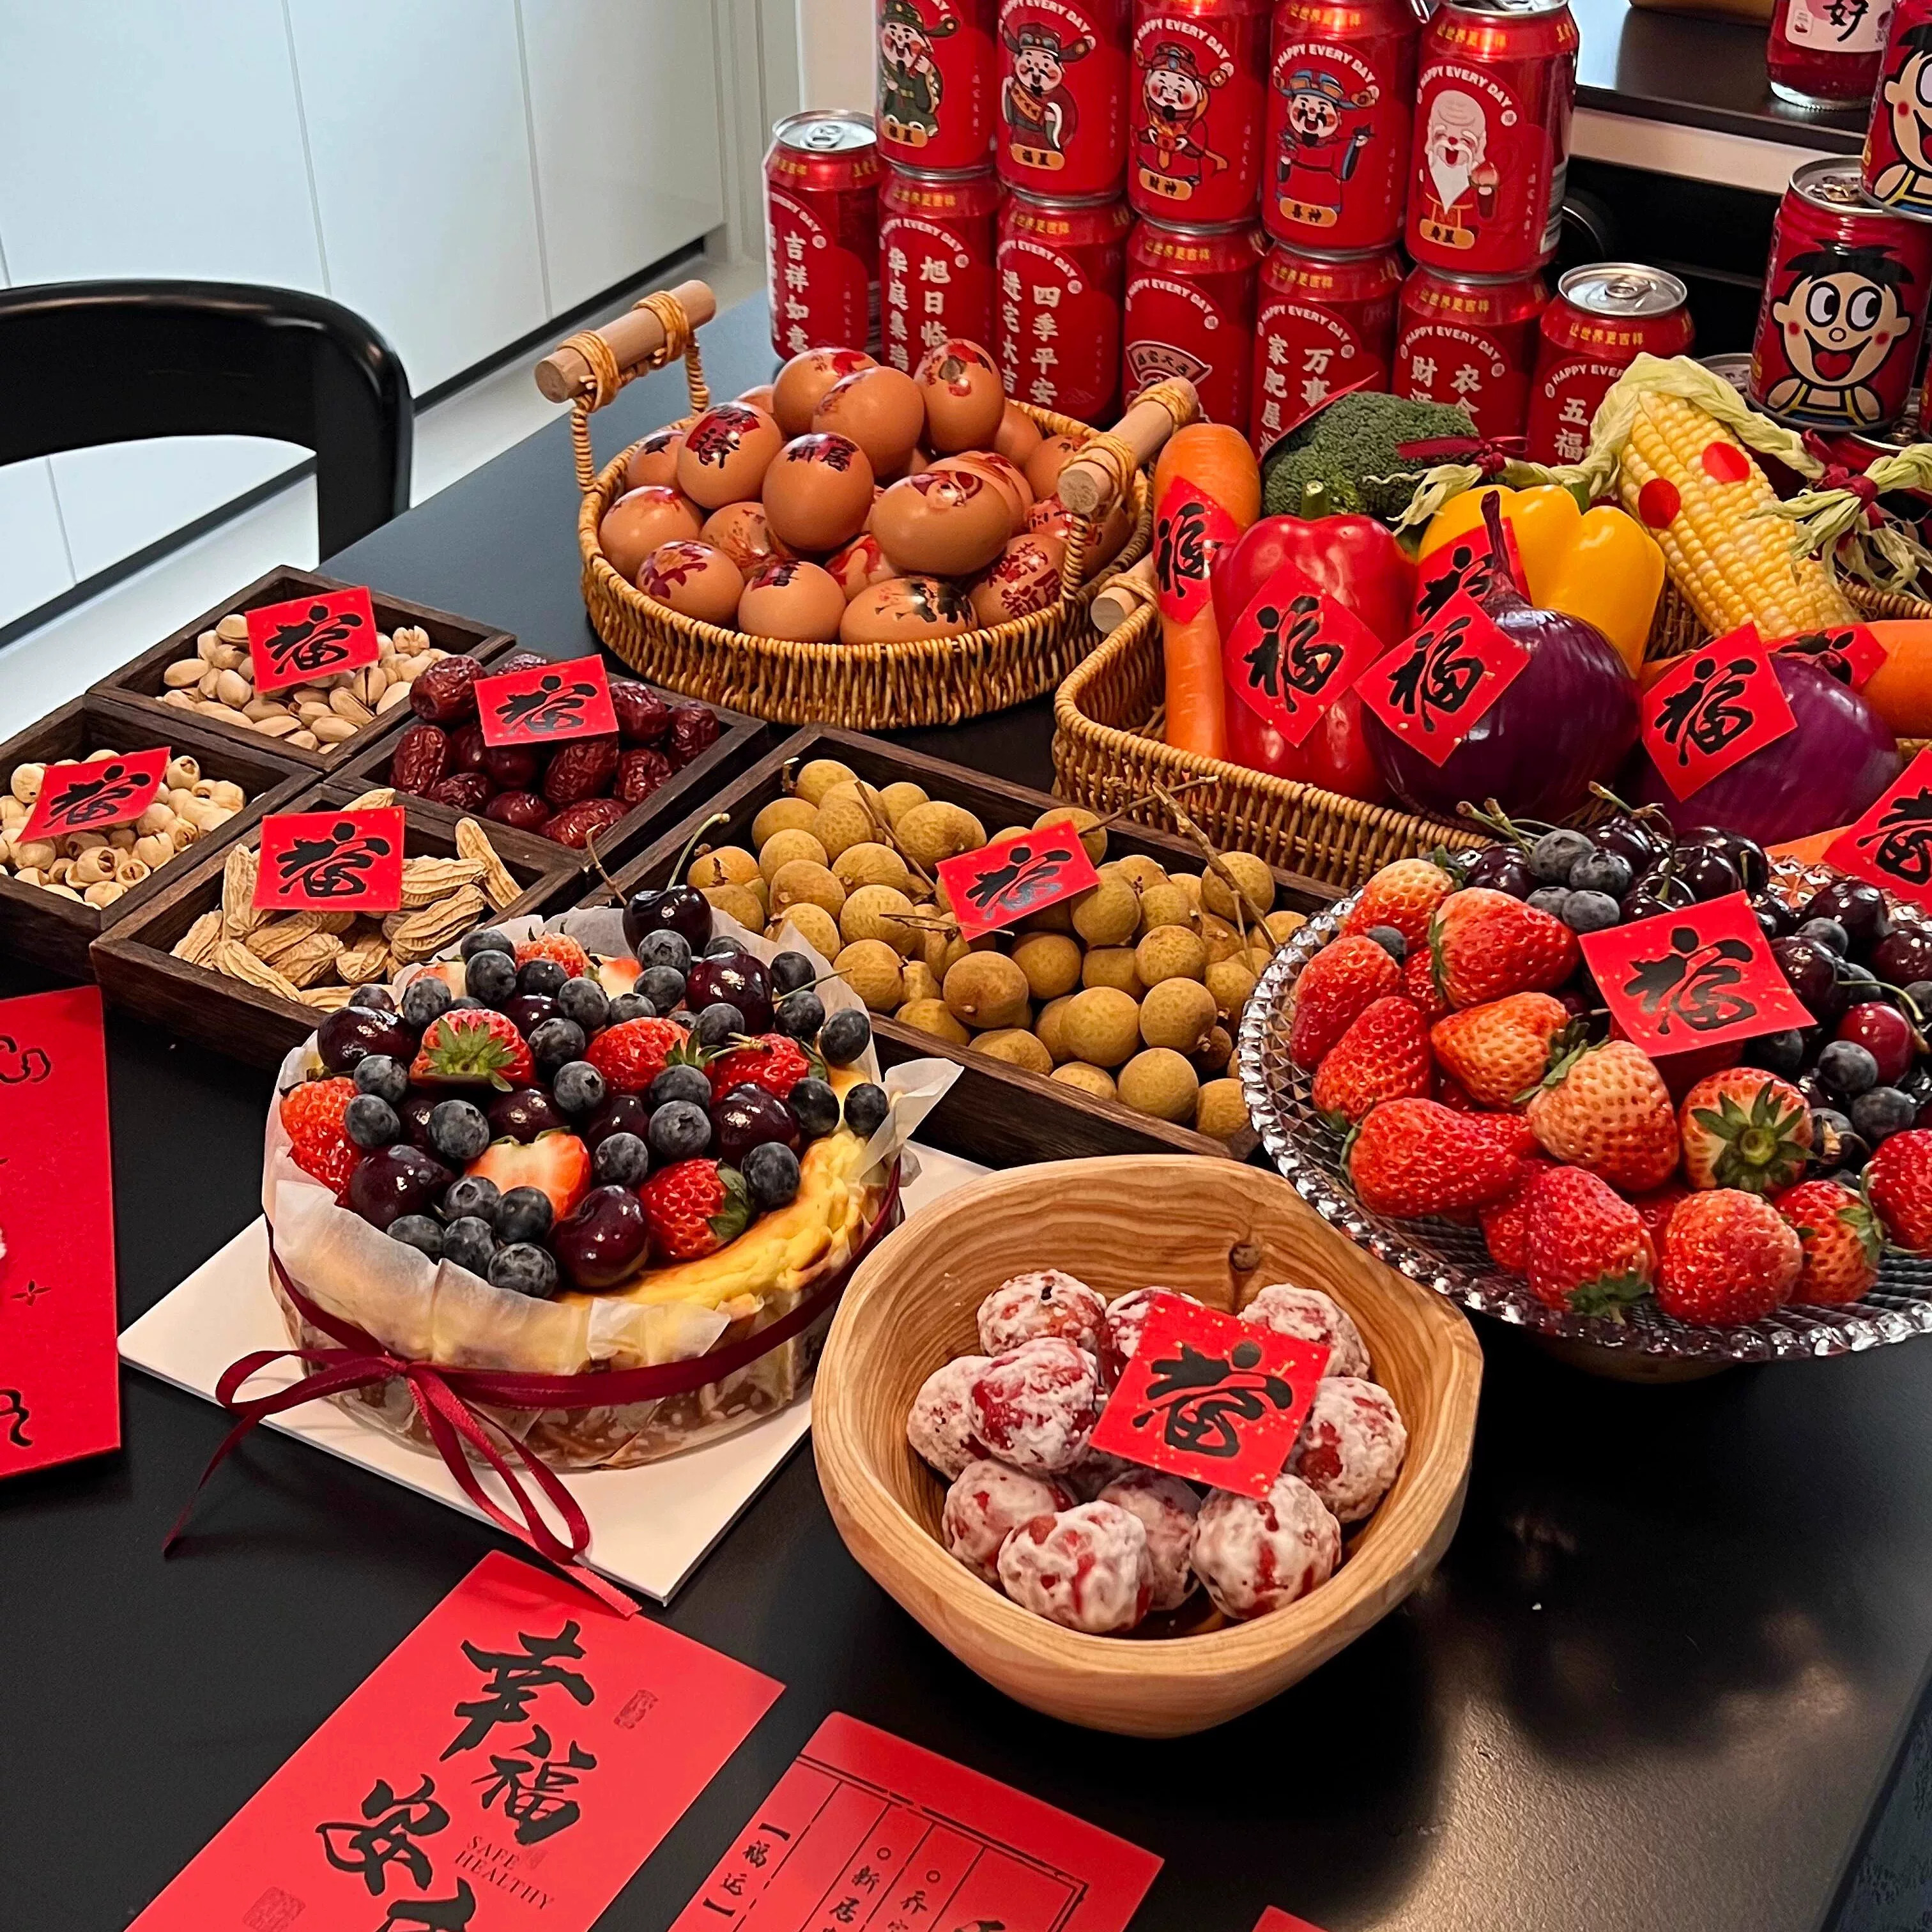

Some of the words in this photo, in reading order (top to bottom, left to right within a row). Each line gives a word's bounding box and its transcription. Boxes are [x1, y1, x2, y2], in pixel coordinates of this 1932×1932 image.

[1137, 19, 1162, 38] HAPPY
[1165, 19, 1208, 43] EVERY
[1206, 34, 1230, 59] DAY
[1822, 0, 1869, 42] 好
[1278, 44, 1305, 67] HAPPY
[1309, 44, 1352, 64] EVERY
[1351, 58, 1375, 82] DAY
[1420, 65, 1443, 88] HAPPY
[1446, 66, 1488, 88] EVERY
[1487, 82, 1513, 107] DAY
[1029, 285, 1061, 406] 四季平安
[1288, 305, 1329, 325] EVERY
[1328, 321, 1351, 341] DAY
[1406, 326, 1433, 346] HAPPY
[1436, 326, 1479, 345] EVERY
[1478, 341, 1501, 360] DAY
[1552, 364, 1586, 385] HAPPY
[1156, 502, 1222, 597] 福
[265, 605, 363, 674] 福
[1243, 595, 1344, 713] 福
[496, 675, 597, 732] 福
[1388, 617, 1485, 732] 福
[1654, 658, 1758, 766] 福
[43, 765, 152, 829] 福
[277, 822, 390, 898] 福
[966, 847, 1072, 919] 福
[1625, 928, 1756, 1035] 福
[1133, 1341, 1293, 1458] 福
[440, 1620, 598, 1846] 幸福
[455, 1850, 555, 1910] HEALTHY
[468, 1835, 520, 1871] SAFE
[822, 1865, 880, 1932] 新居
